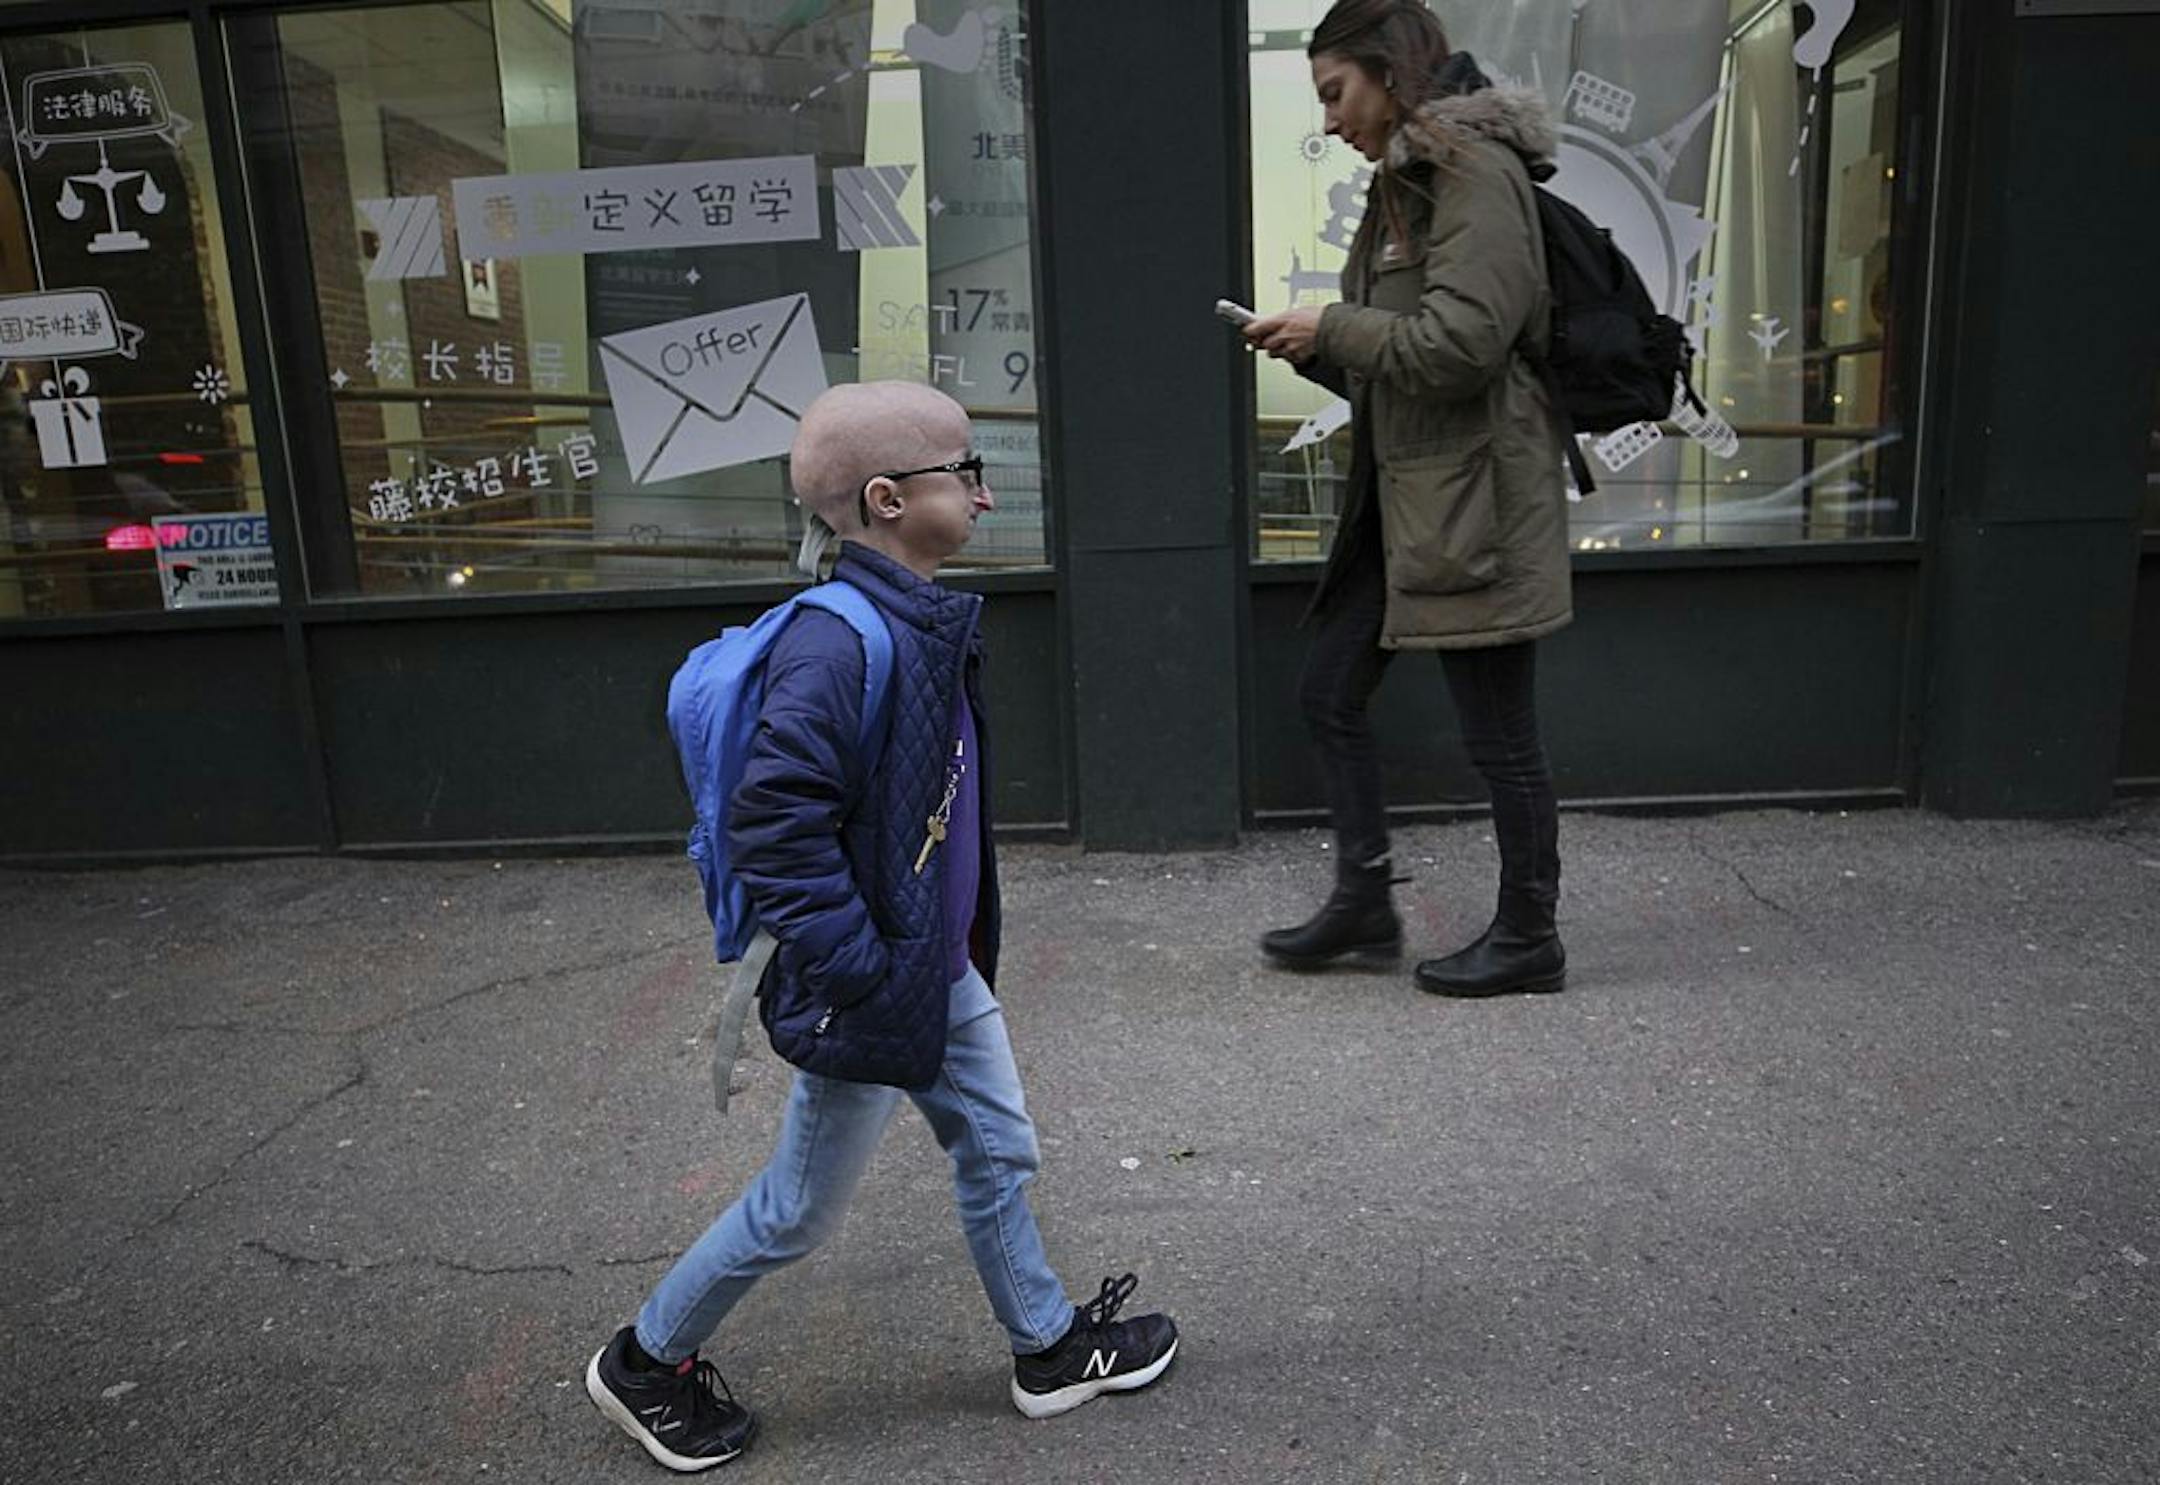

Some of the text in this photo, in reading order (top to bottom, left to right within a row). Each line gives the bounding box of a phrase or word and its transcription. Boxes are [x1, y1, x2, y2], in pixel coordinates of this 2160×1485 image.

[43, 85, 153, 121] 法律服务
[0, 310, 102, 344] 国际快递
[365, 337, 568, 391] 校长指导
[660, 321, 764, 377] Offer
[368, 430, 600, 523] 藤校招生官
[168, 520, 268, 549] NOTICE
[215, 569, 234, 586] 24
[1081, 1348, 1120, 1379] N
